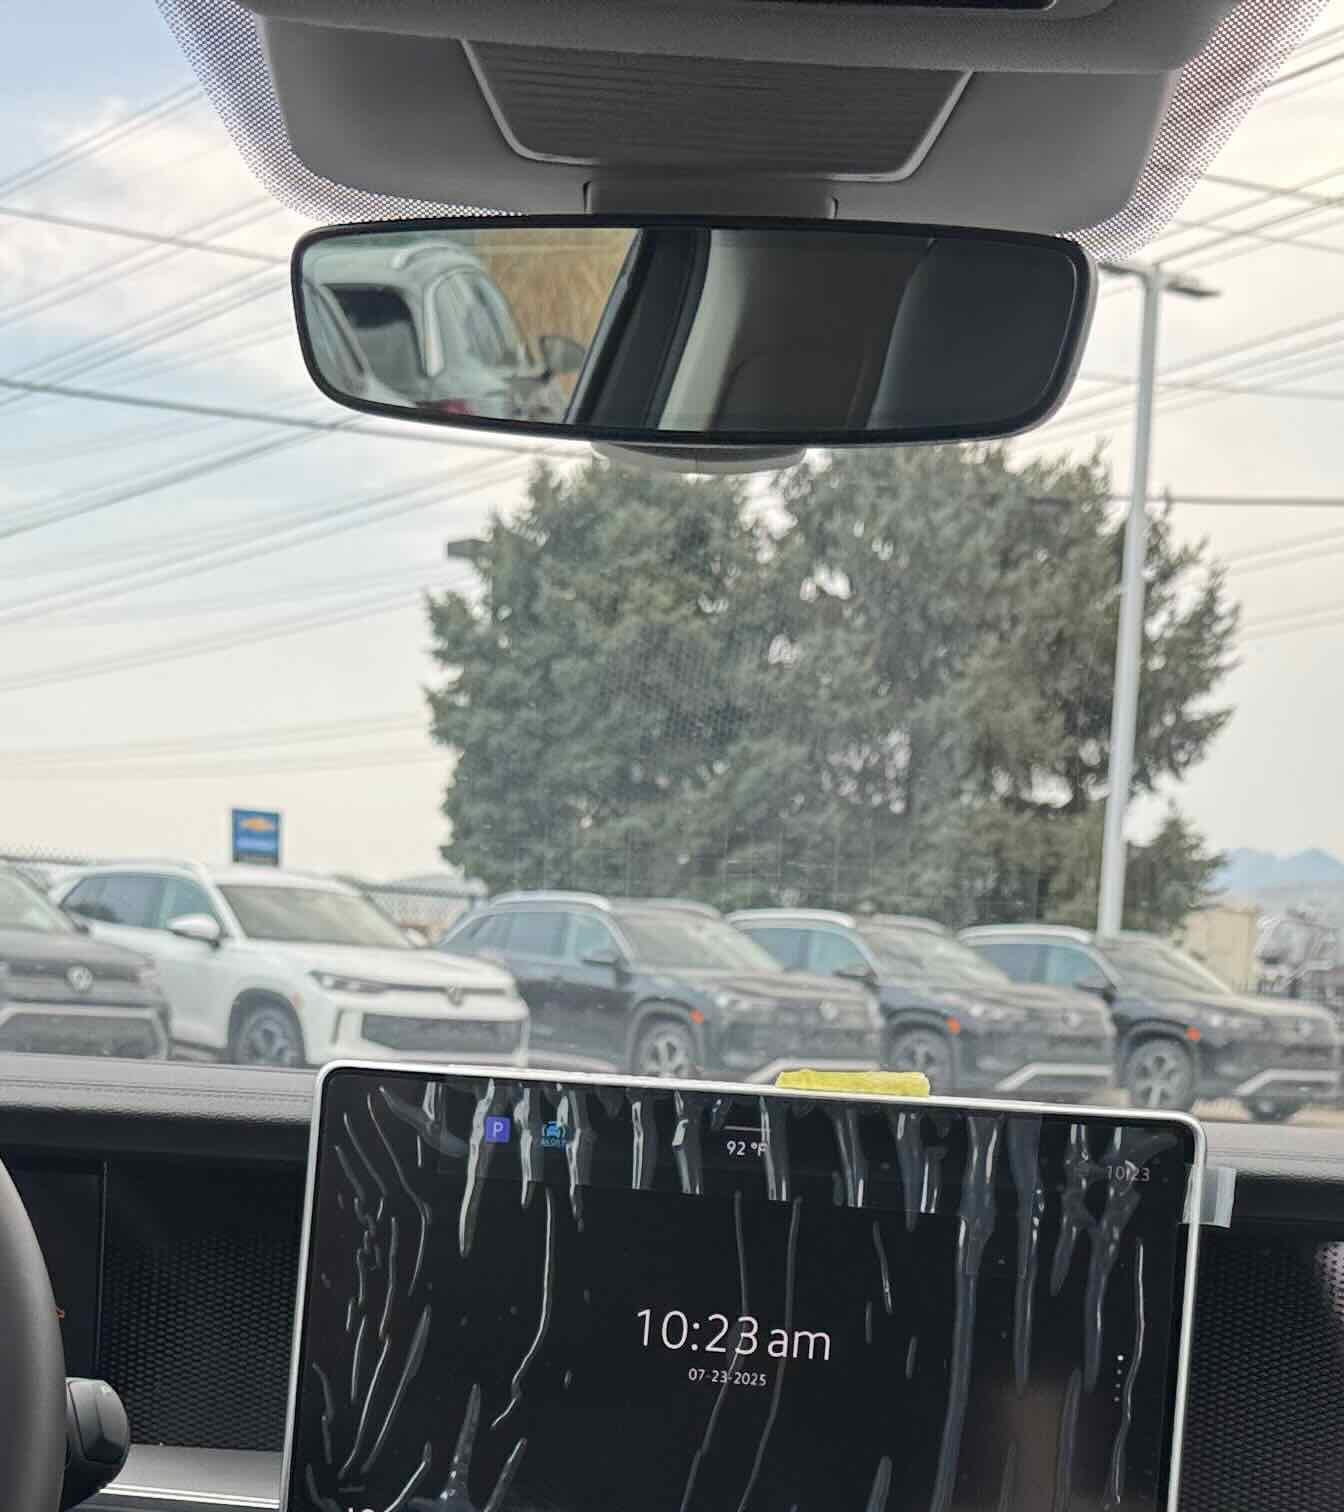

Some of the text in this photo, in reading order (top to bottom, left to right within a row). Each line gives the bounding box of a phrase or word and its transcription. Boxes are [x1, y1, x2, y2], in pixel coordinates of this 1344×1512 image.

[492, 1121, 505, 1135] P
[726, 1140, 745, 1156] 92
[688, 1368, 767, 1386] 07-23-2025
